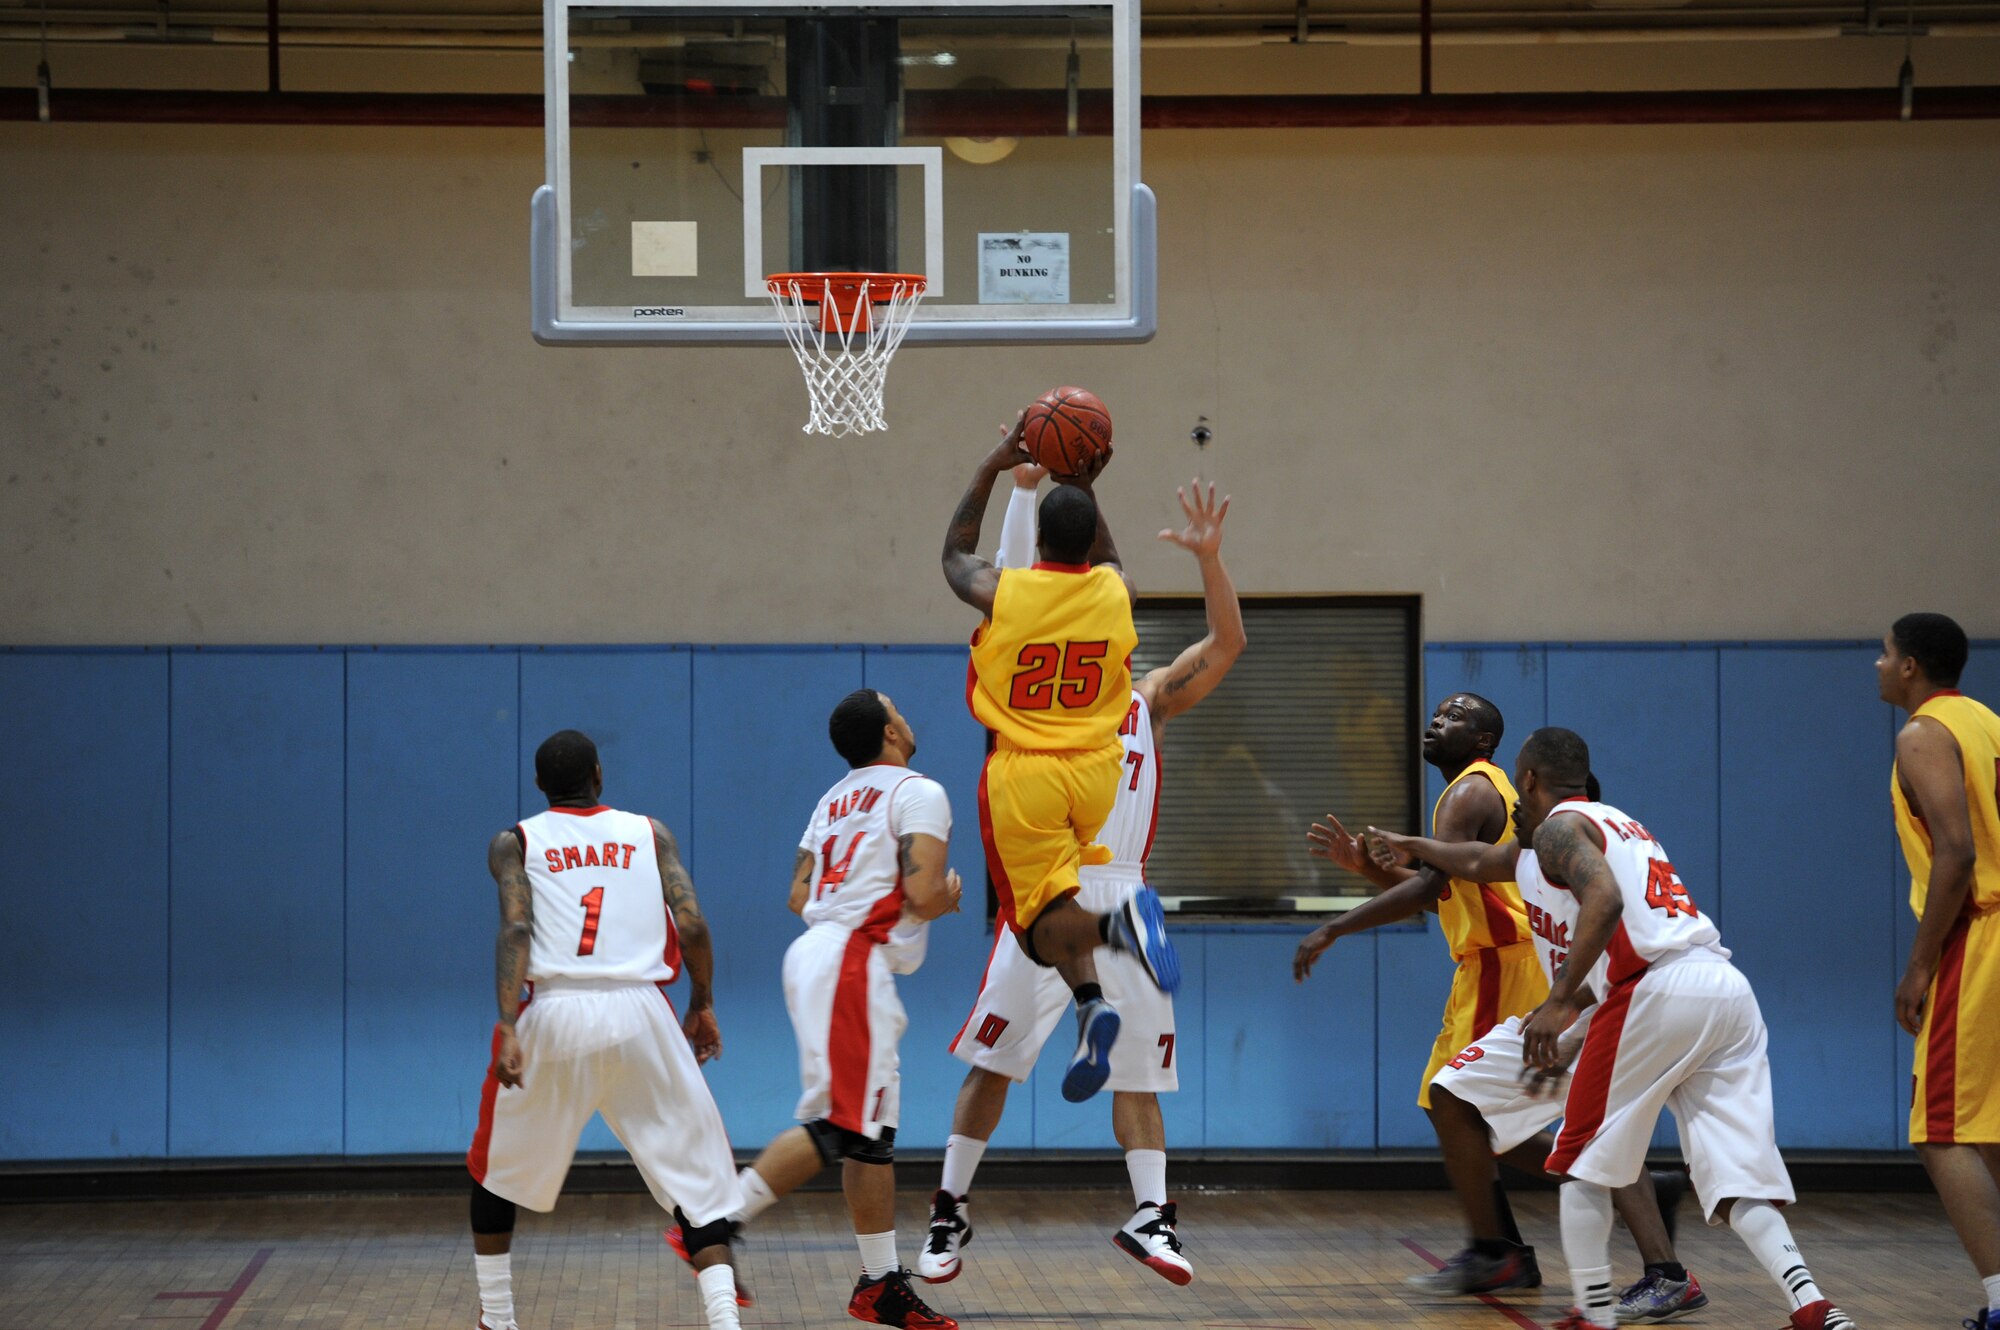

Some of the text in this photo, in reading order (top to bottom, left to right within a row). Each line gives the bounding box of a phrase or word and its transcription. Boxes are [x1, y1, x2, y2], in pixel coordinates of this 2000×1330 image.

[1000, 268, 1048, 277] DUNKING
[1017, 255, 1031, 264] NO
[1008, 640, 1109, 710] 25
[544, 842, 636, 873] SMART
[816, 831, 867, 901] 14
[1645, 856, 1699, 919] 45
[577, 886, 604, 957] 1
[1158, 1033, 1175, 1069] 7
